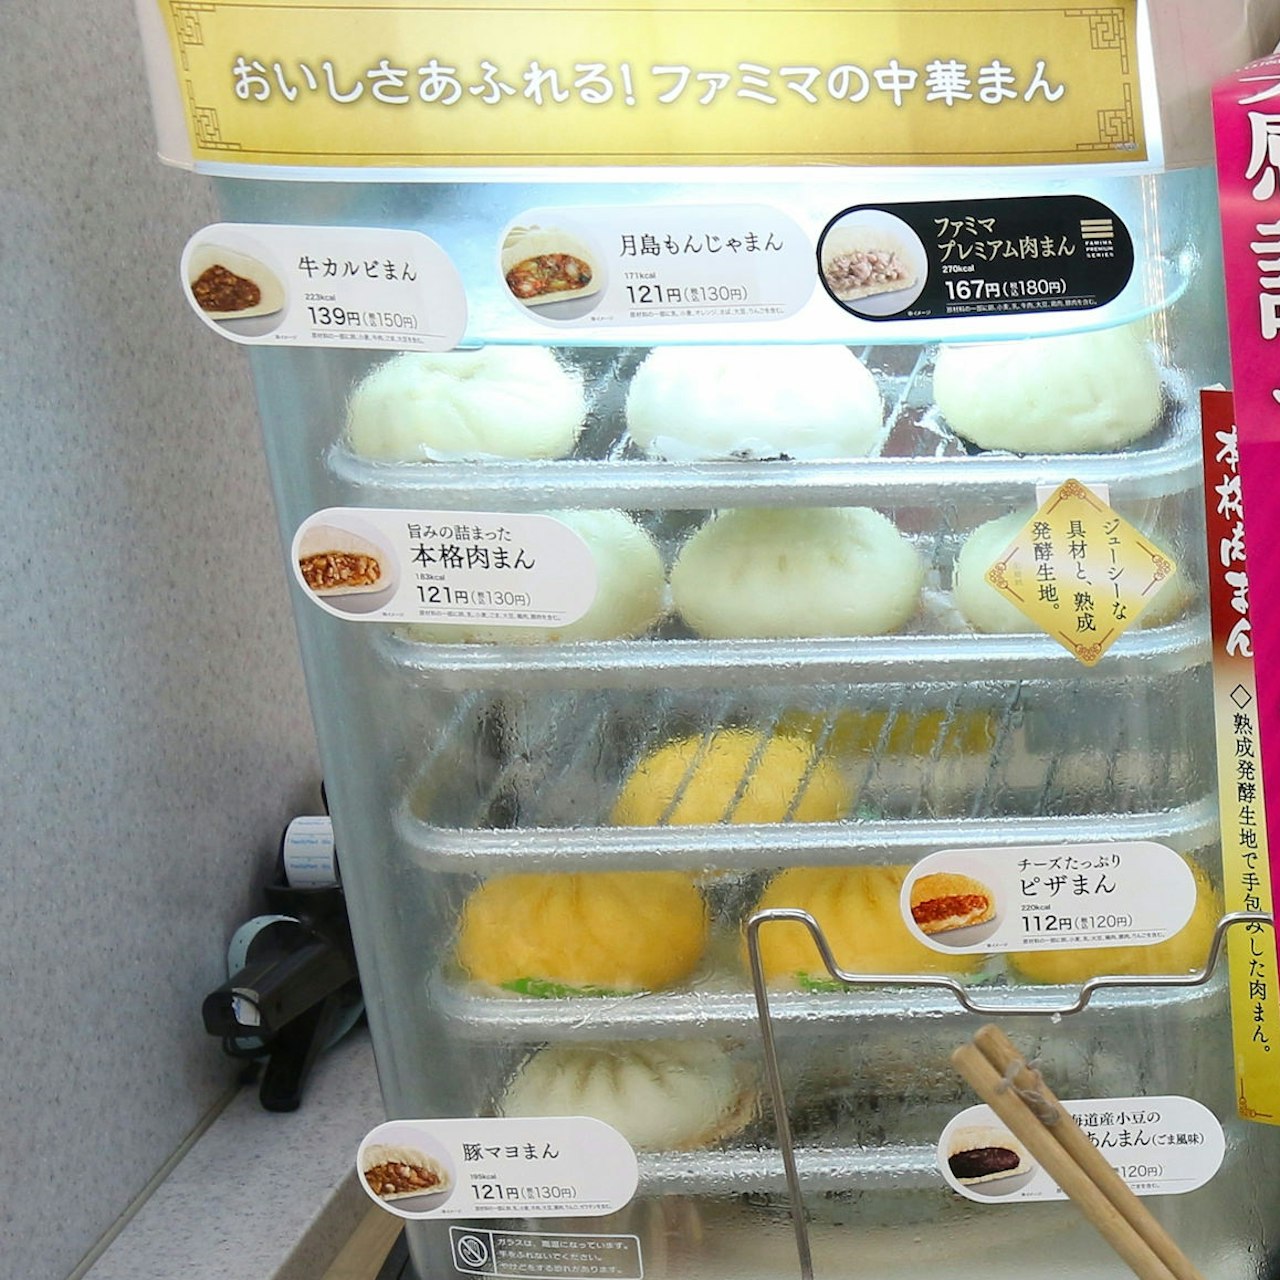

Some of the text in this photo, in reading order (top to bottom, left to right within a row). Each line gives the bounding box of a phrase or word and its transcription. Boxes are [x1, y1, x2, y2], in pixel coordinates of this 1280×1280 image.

[652, 58, 1066, 106] ファミマの中華まん
[935, 216, 995, 238] ファミマ
[620, 232, 784, 258] 月島もんじゃまん
[939, 234, 1076, 264] プレミアム肉まん
[1085, 239, 1114, 247] FAMIMA
[298, 255, 418, 283] 牛カルビまん
[943, 265, 975, 274] 270kcal
[305, 292, 336, 301] 223kcal
[408, 523, 512, 542] 旨みの詰まった
[410, 544, 536, 569] 本格肉まん
[1031, 521, 1060, 613] 発酵生地。
[1103, 516, 1126, 620] ジューシーな
[1066, 519, 1096, 632] 具材と、熟成
[1017, 853, 1122, 872] チーズたっぷり
[1020, 874, 1116, 897] ピザまん
[463, 1143, 559, 1162] 豚マヨまん
